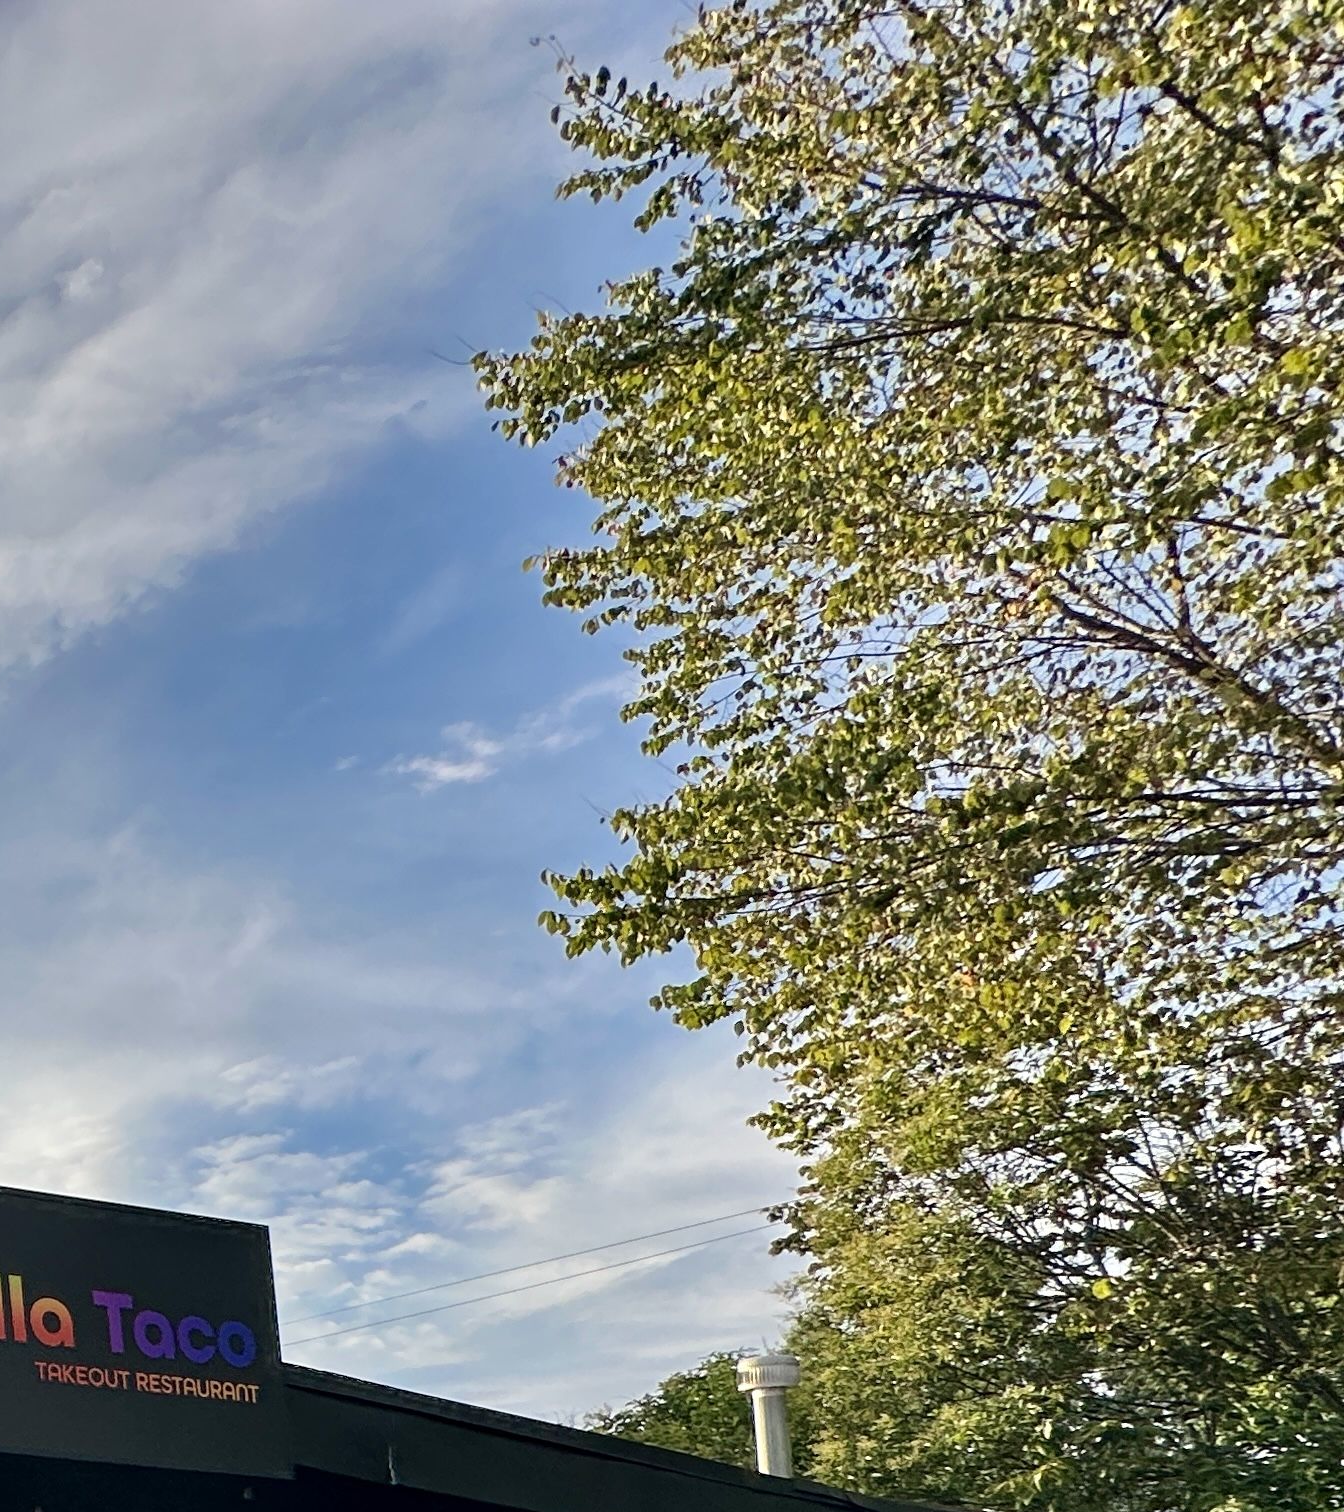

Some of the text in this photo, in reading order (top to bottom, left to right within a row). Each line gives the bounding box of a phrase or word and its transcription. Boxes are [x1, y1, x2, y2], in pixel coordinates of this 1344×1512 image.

[91, 1289, 257, 1368] Taco
[34, 1361, 260, 1404] TAKEOUT RESTAURANT
